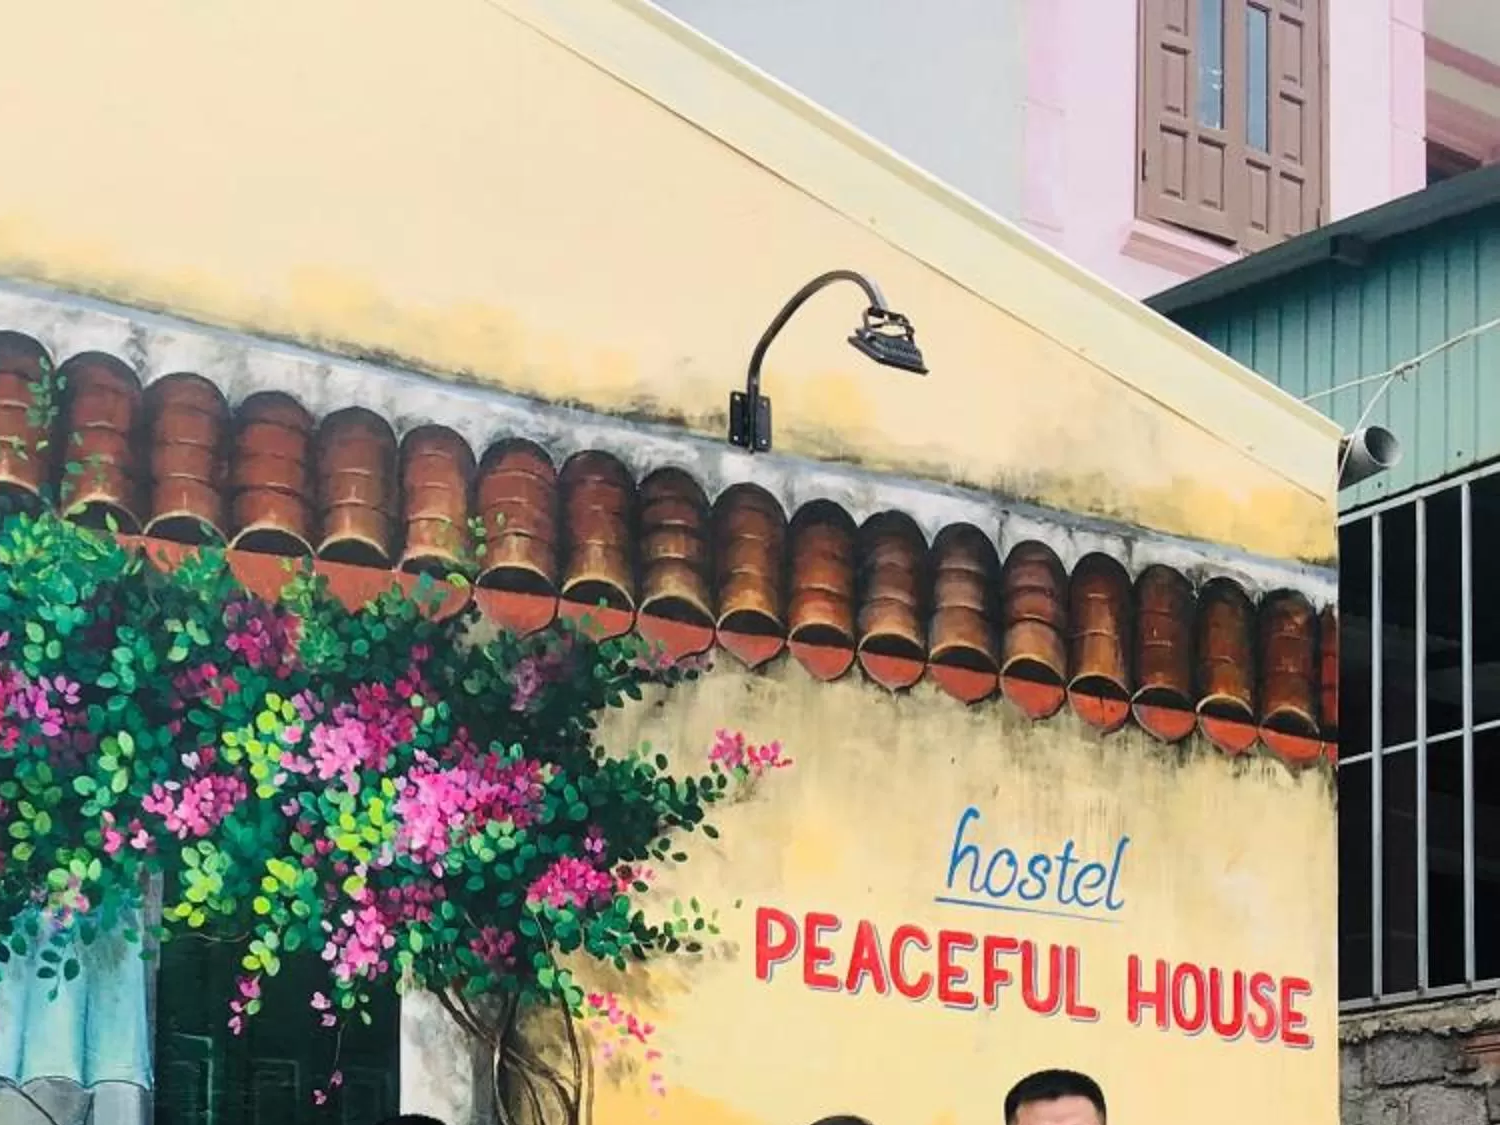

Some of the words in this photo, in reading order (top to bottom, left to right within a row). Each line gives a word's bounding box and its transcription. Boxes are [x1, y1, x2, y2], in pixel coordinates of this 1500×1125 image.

[948, 806, 1130, 910] hostel
[755, 907, 1099, 1021] PEACEFUL
[1128, 954, 1313, 1048] HOUSE
